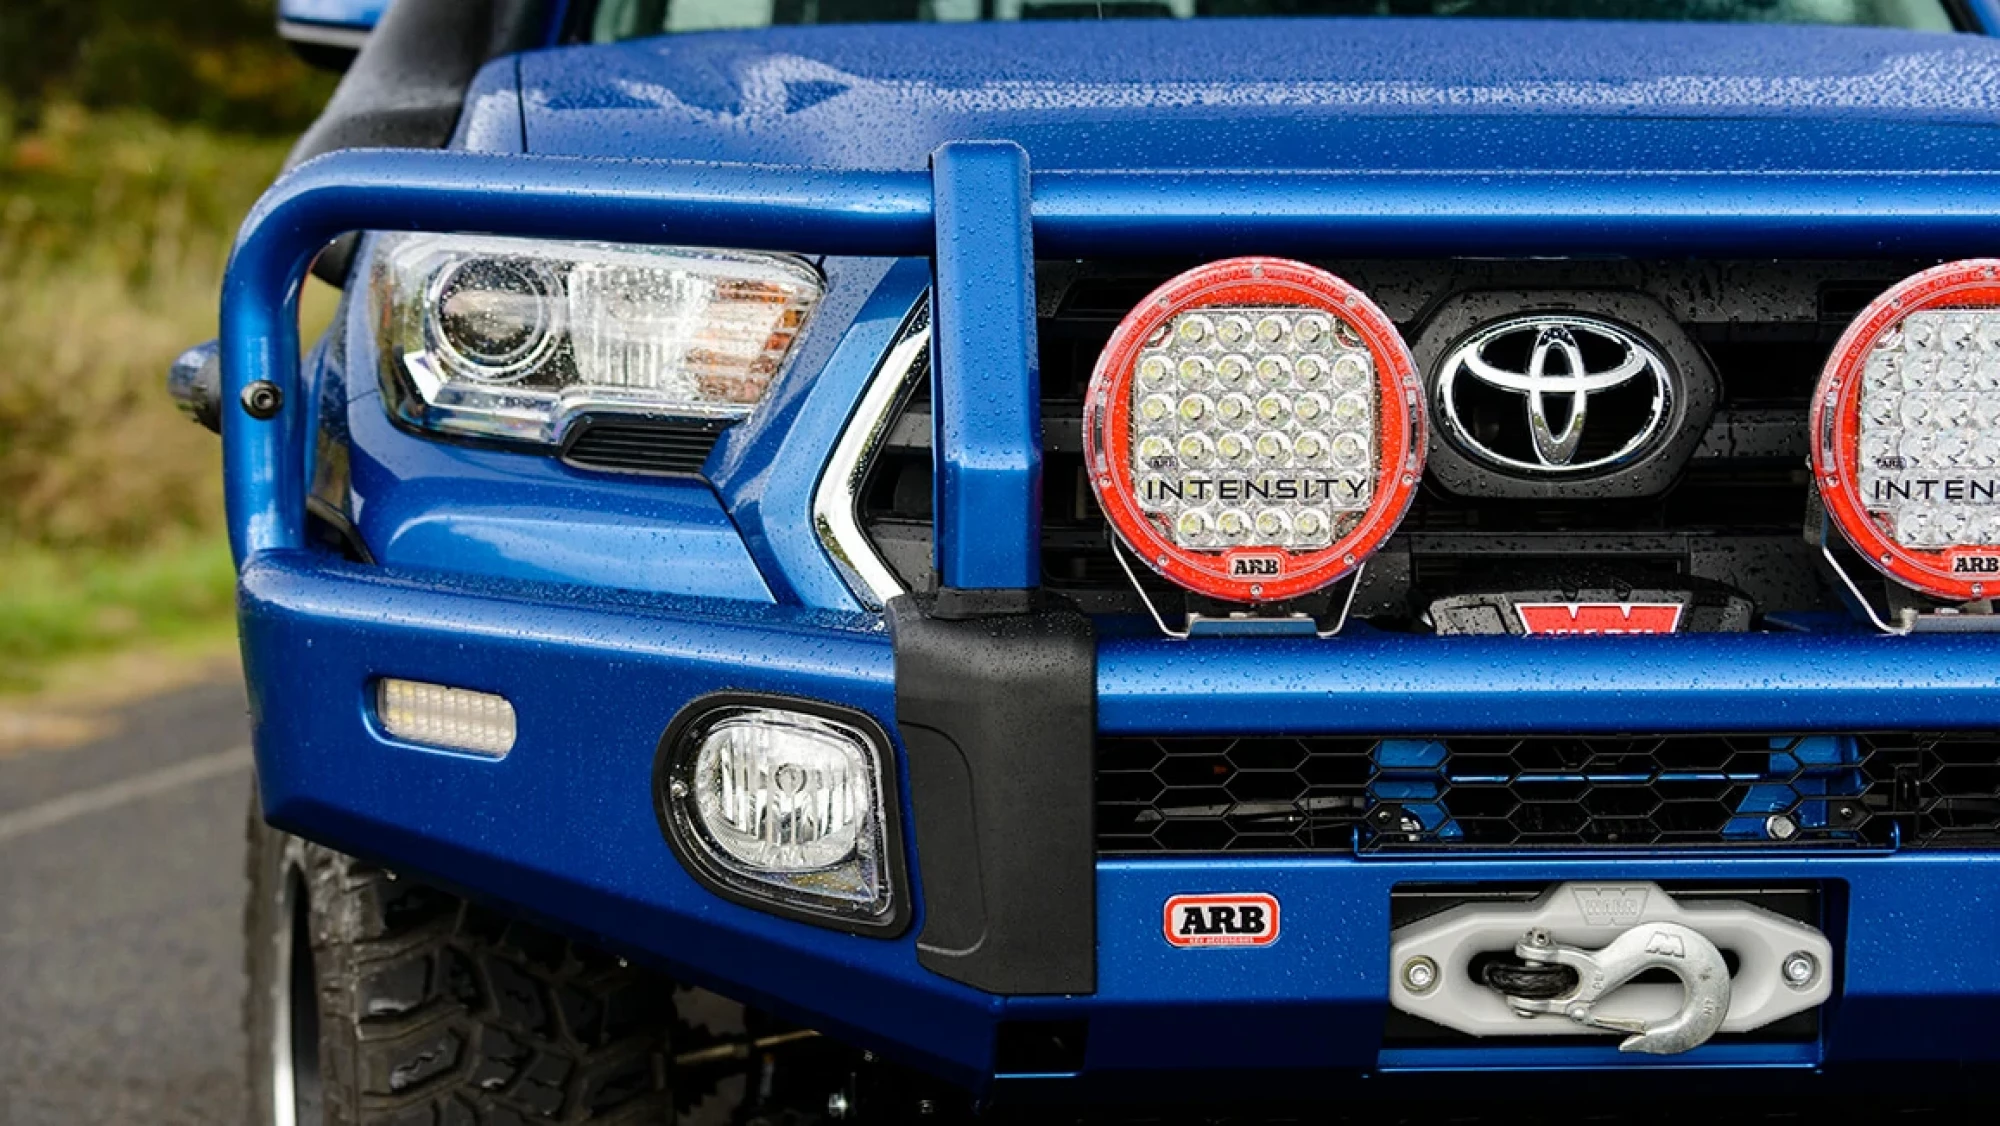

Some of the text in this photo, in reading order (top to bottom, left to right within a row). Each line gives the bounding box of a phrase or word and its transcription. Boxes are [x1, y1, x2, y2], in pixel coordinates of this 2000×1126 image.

[1147, 479, 1367, 500] INTENSITY
[1875, 479, 2000, 500] INTEN
[1234, 559, 1279, 575] ARB
[1954, 557, 1999, 573] ARB
[1179, 906, 1266, 935] ARB
